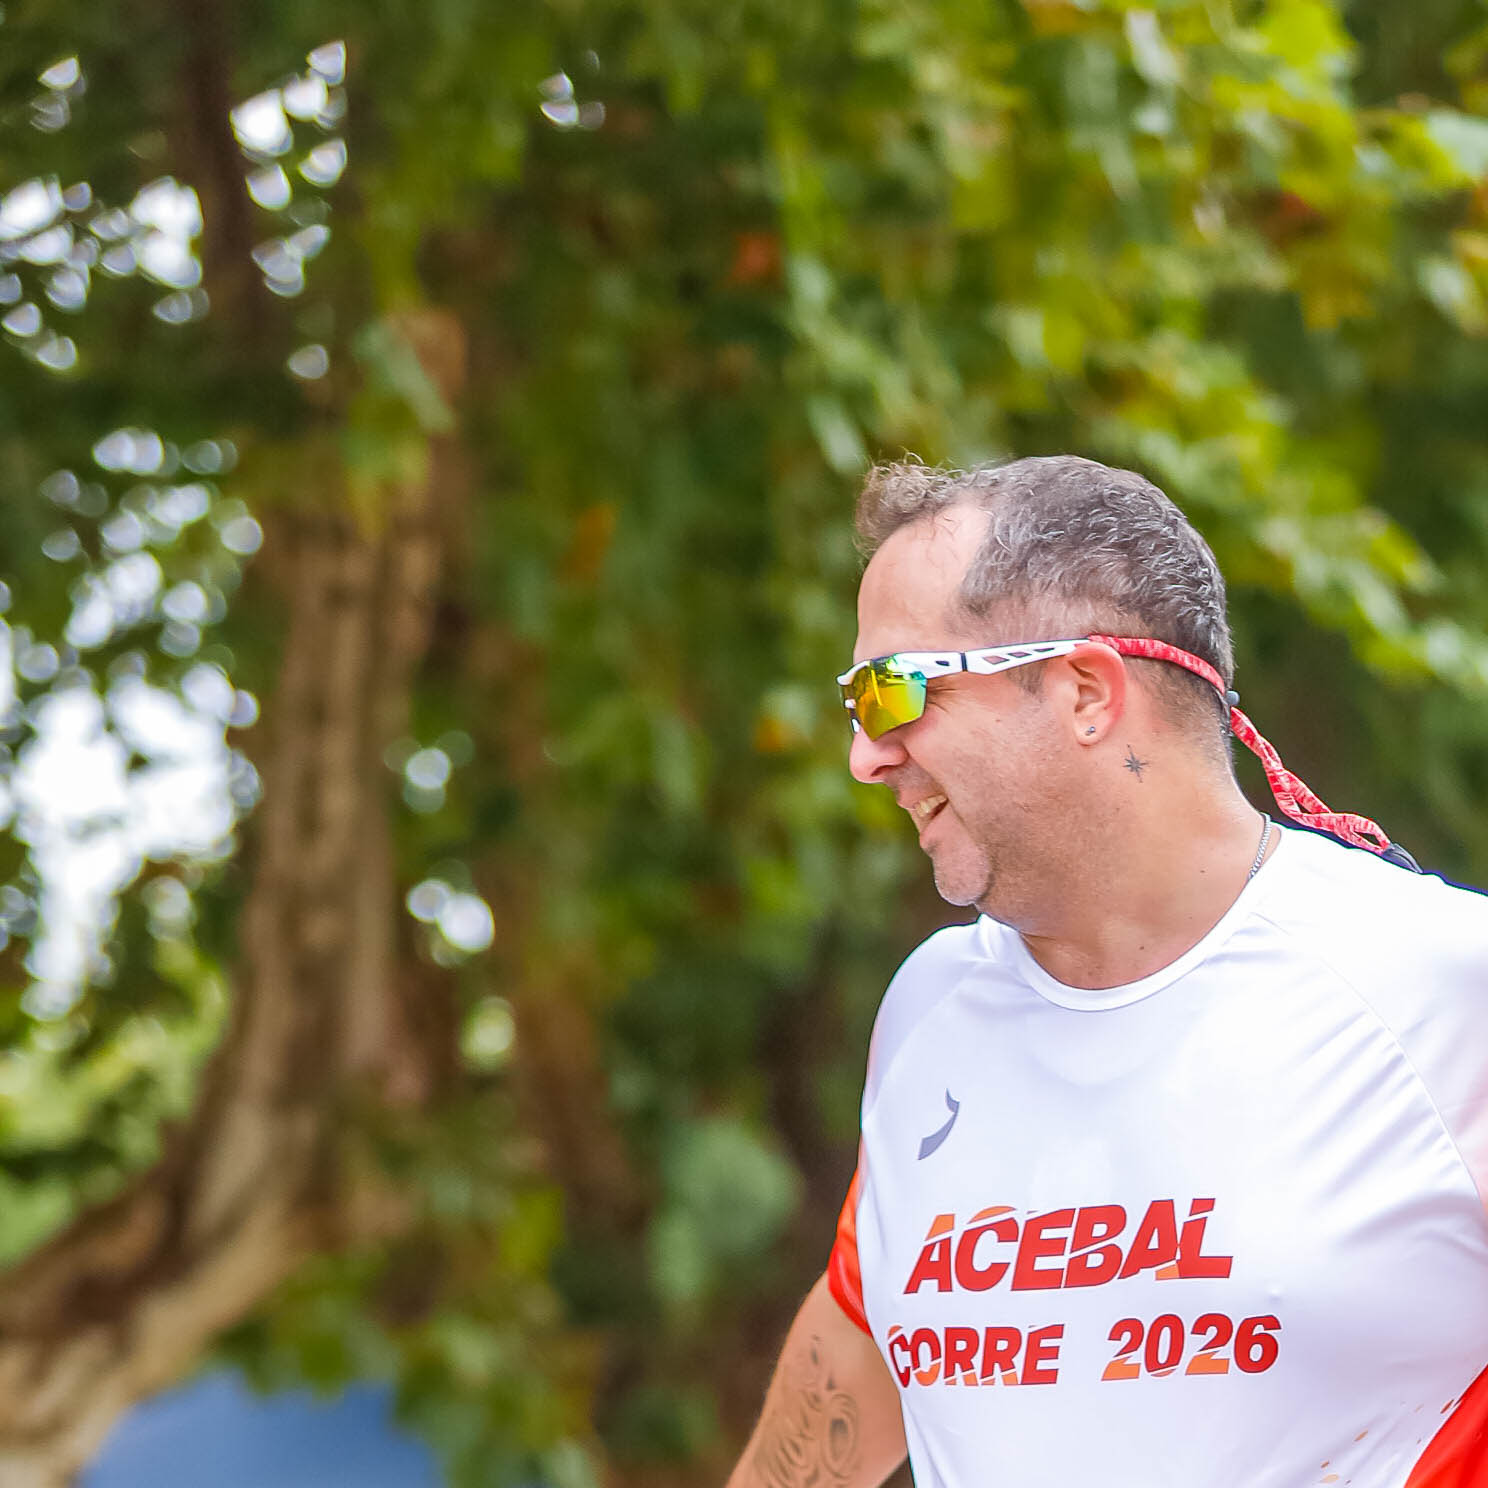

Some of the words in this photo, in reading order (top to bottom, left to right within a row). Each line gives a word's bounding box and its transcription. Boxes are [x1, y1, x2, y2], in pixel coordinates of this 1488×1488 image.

[903, 1198, 1234, 1294] ACEBAL
[888, 1324, 1064, 1388] CORRE
[1101, 1313, 1282, 1381] 2026
